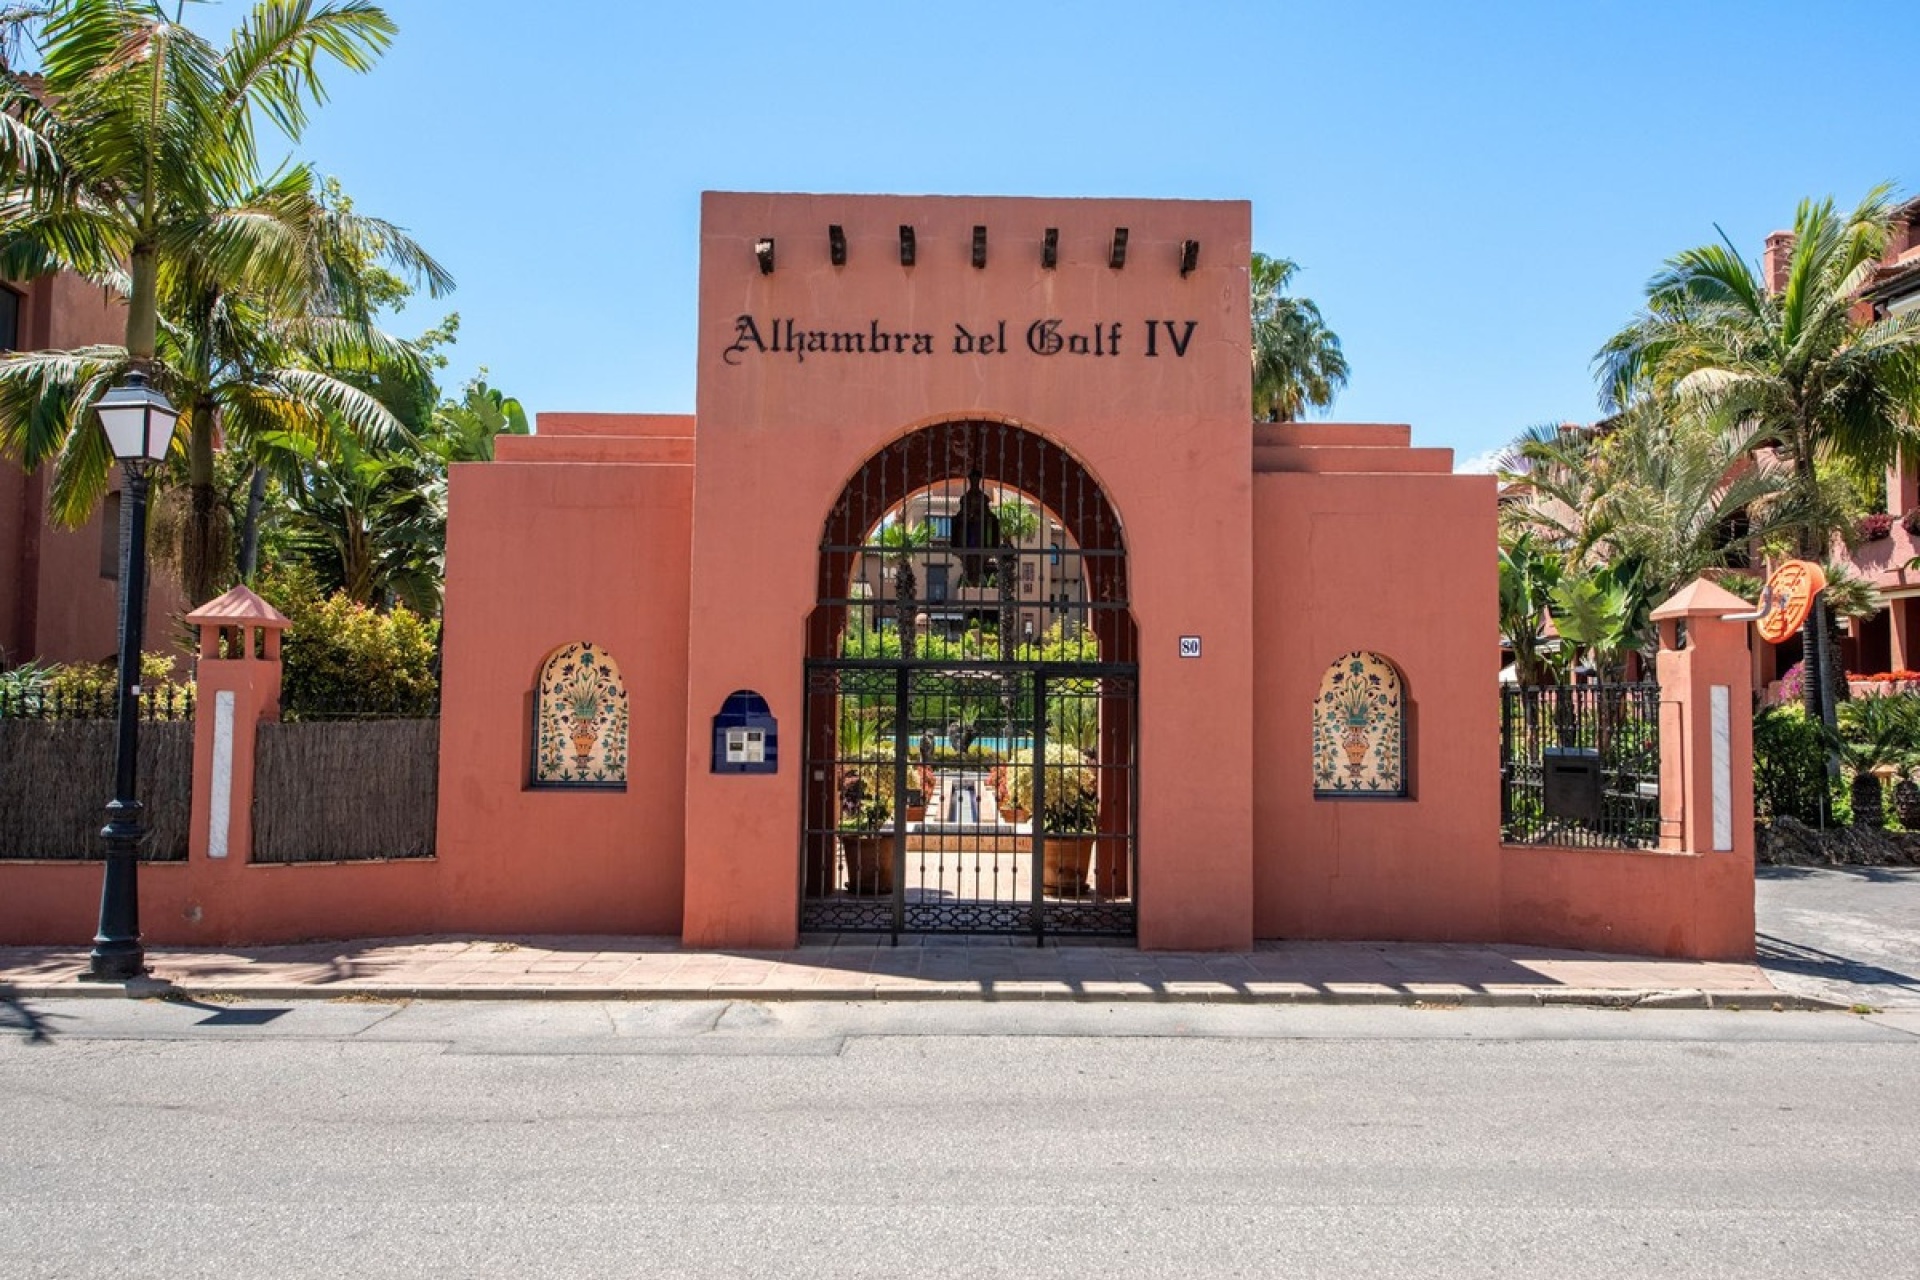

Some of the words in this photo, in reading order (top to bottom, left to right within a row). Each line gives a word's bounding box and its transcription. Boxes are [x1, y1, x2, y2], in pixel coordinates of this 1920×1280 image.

[723, 314, 934, 366] Alhambra
[953, 322, 1007, 356] del
[1026, 319, 1123, 357] Golf
[1144, 319, 1198, 358] IV
[1182, 640, 1198, 653] 80
